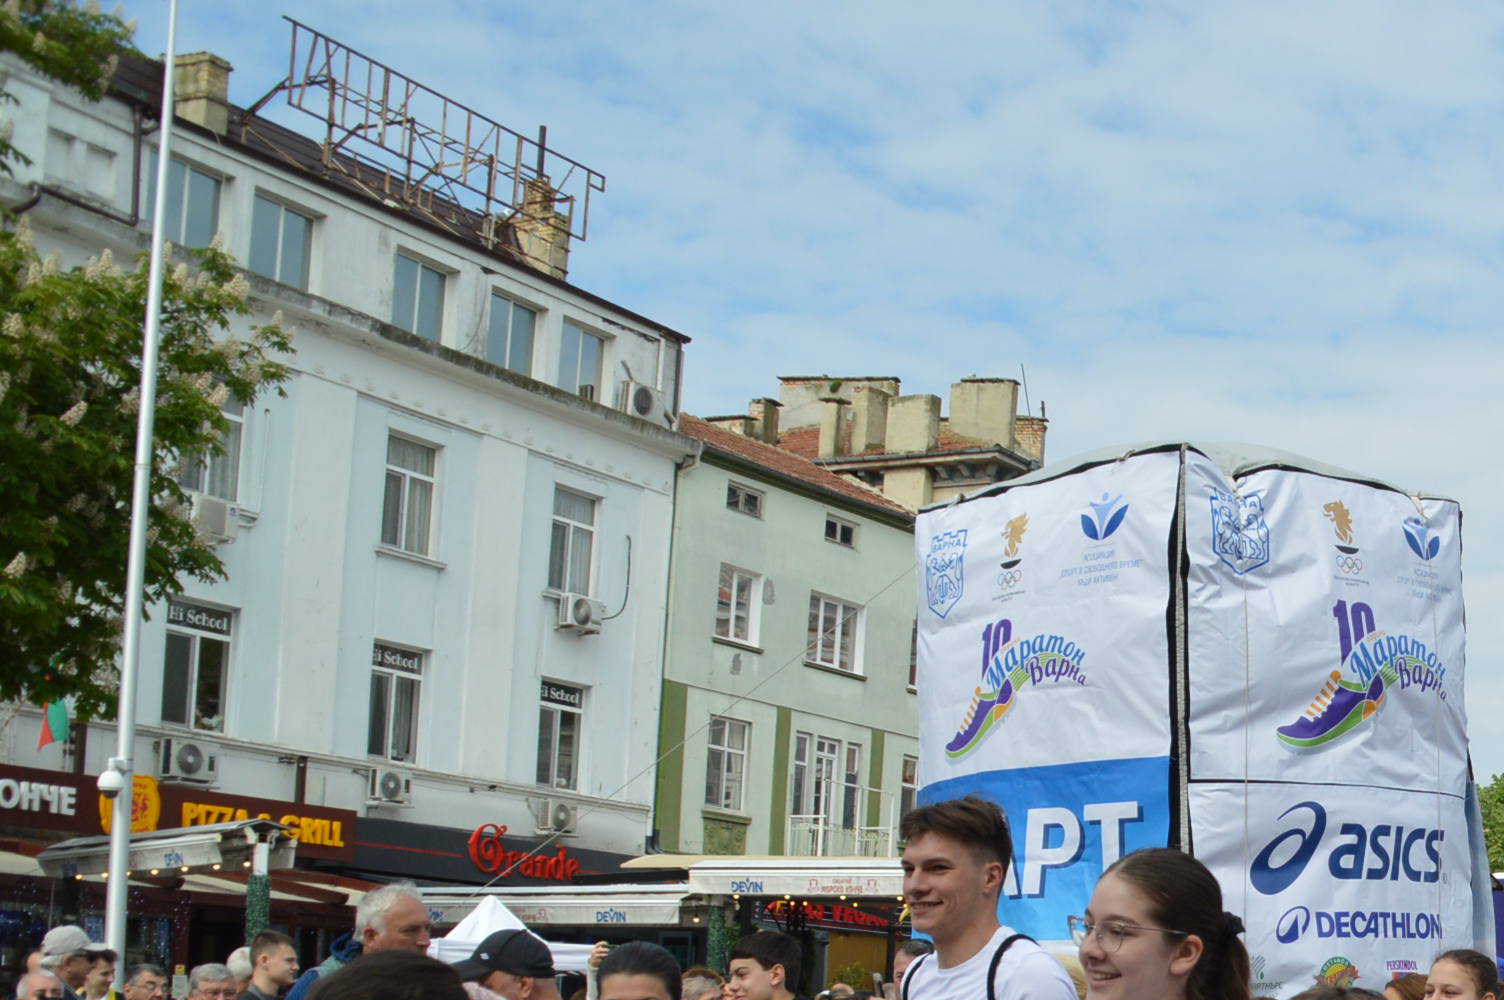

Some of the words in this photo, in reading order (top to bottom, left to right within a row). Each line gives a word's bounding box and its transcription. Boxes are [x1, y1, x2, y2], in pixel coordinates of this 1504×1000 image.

[168, 605, 183, 621] Hi
[186, 609, 228, 631] School
[1332, 599, 1376, 667] 10
[384, 650, 419, 670] School
[981, 618, 1012, 681] 10
[987, 634, 1085, 693] Маратон
[1350, 634, 1446, 689] Маратон
[1025, 656, 1087, 686] Варна
[550, 688, 580, 704] School
[280, 814, 345, 848] GRILL
[468, 823, 581, 881] Grande
[1003, 801, 1142, 898] РТ
[731, 877, 763, 893] DEVIN
[596, 908, 626, 922] DEVIN
[1315, 910, 1443, 939] DECATHLON
